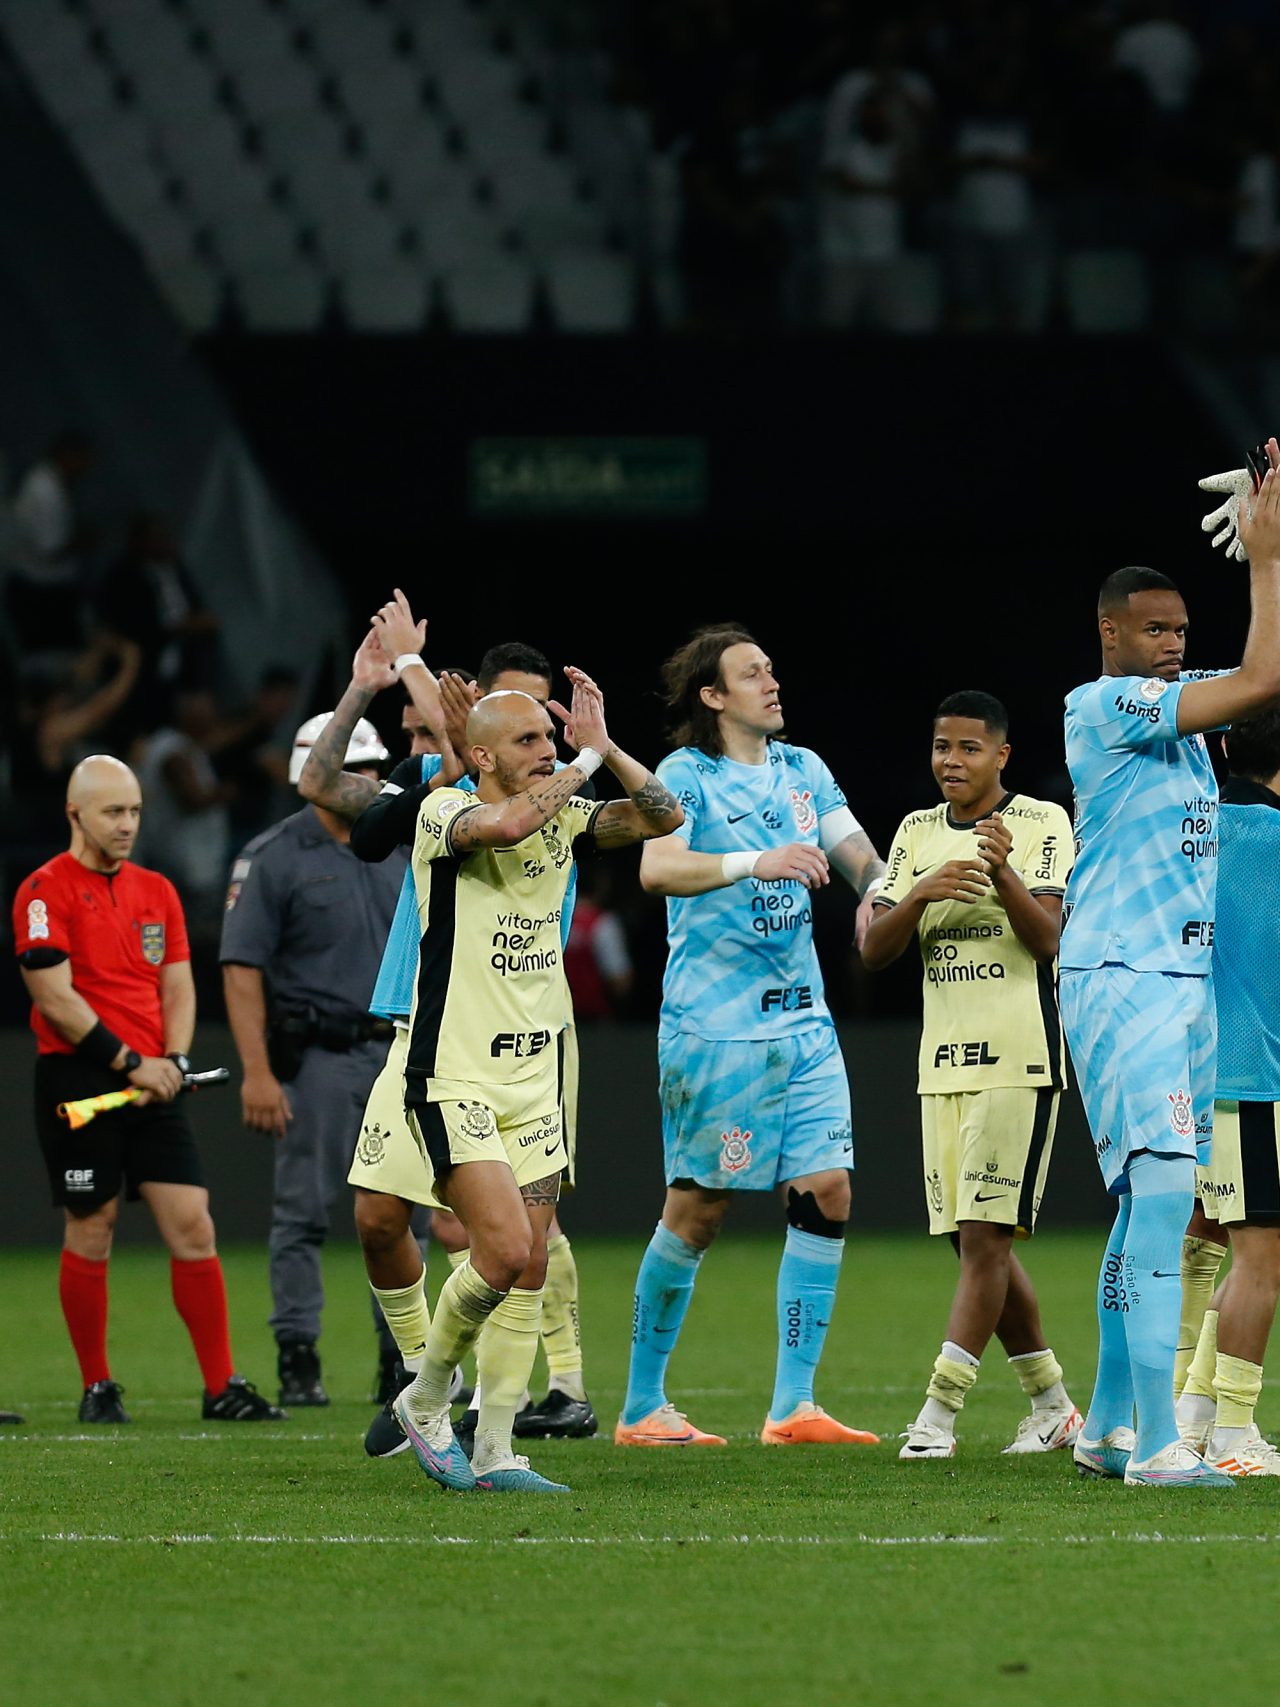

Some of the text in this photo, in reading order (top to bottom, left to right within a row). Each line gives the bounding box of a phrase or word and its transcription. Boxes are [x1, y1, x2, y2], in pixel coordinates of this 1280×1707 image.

[1125, 699, 1160, 723] bmg
[1182, 817, 1212, 835] neo
[888, 847, 907, 883] bmg
[1036, 845, 1057, 880] bmg
[752, 894, 794, 912] neo
[492, 931, 536, 951] neo
[927, 960, 1005, 988] química
[934, 1041, 1001, 1068] FIEL
[64, 1169, 93, 1183] CBF
[964, 1170, 1021, 1188] UniCesumar
[1103, 1252, 1120, 1312] TODOS
[1126, 1255, 1142, 1305] Cartão de
[786, 1297, 802, 1348] TODOS
